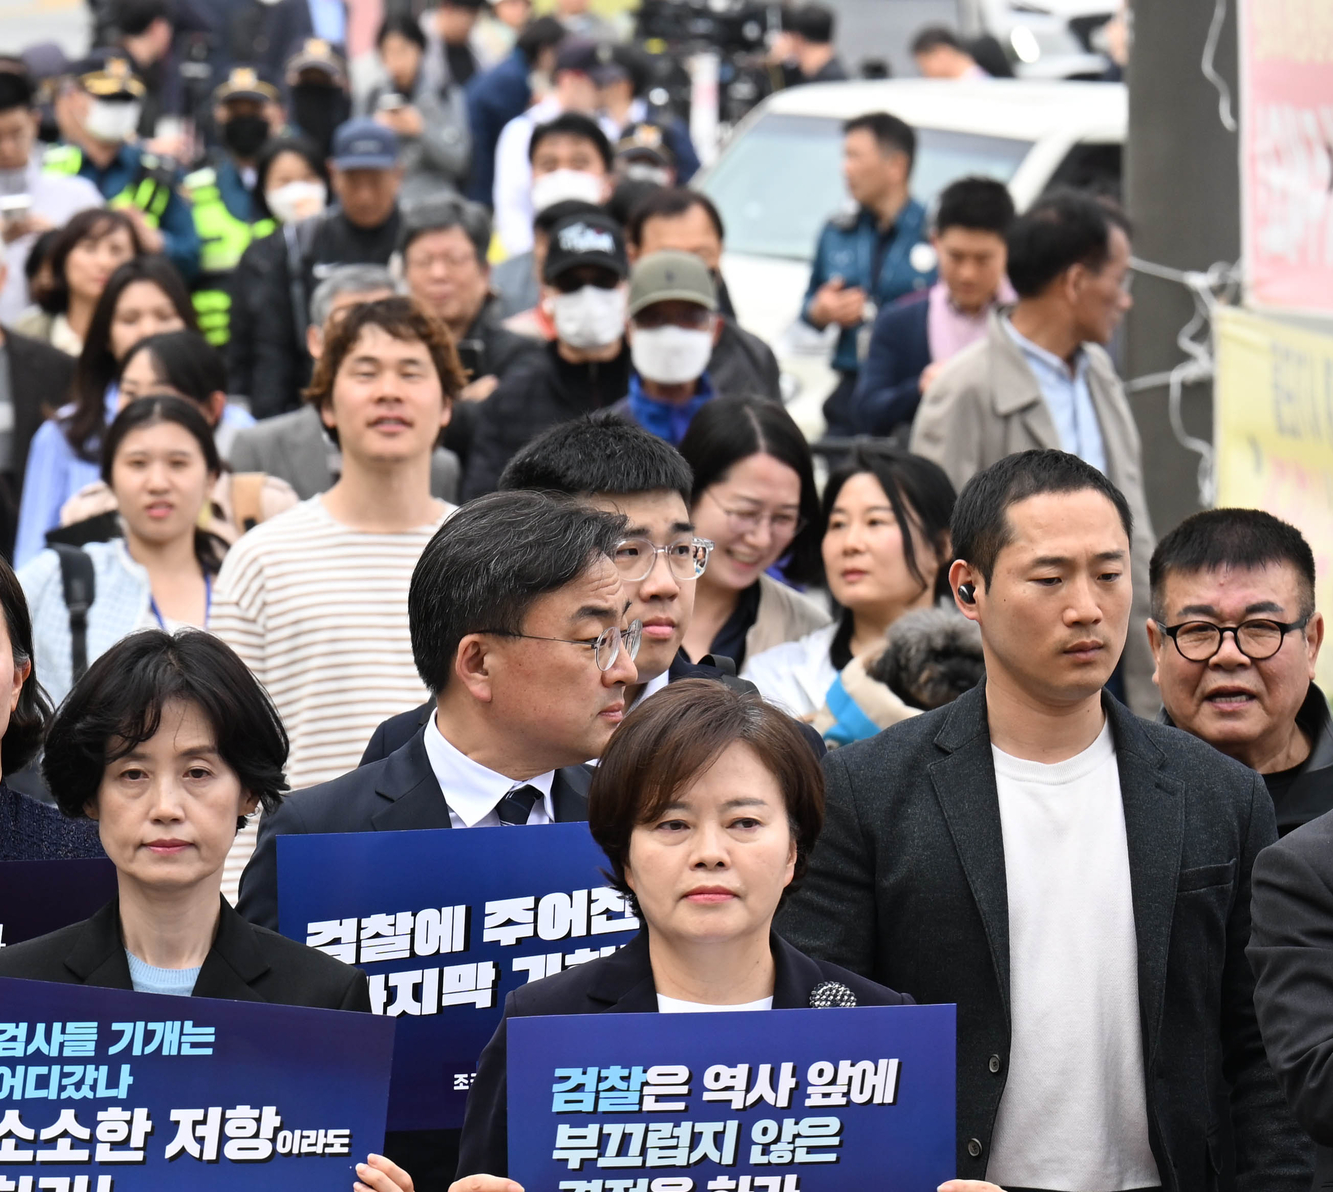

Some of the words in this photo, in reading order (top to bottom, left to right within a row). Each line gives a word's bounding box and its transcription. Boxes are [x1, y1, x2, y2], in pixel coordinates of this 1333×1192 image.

[306, 904, 467, 965] 검찰에
[483, 886, 641, 947] 주어진
[109, 1021, 215, 1055] 기개는
[552, 1065, 689, 1112] 검찰은
[703, 1062, 796, 1109] 역사
[805, 1059, 898, 1106] 앞에
[165, 1105, 350, 1160] 저항이라도
[553, 1120, 738, 1169] 부끄럽지
[750, 1117, 840, 1163] 않은
